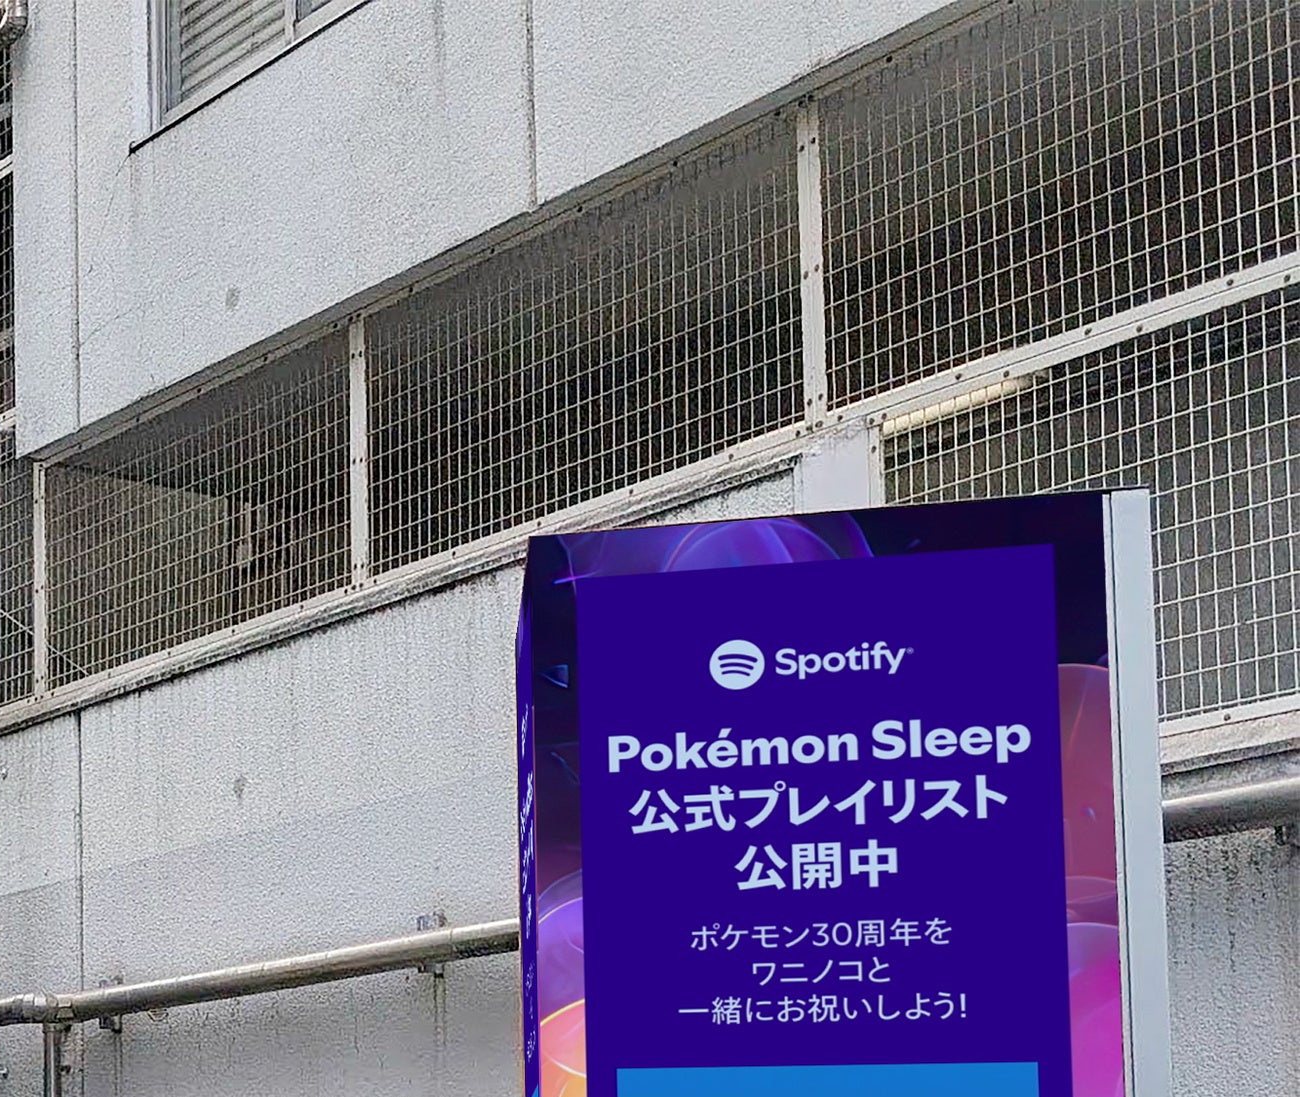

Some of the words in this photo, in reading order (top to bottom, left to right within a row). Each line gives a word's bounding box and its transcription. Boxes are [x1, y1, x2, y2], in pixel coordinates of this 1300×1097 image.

[775, 641, 906, 679] Spotify
[608, 728, 858, 772] Pokémon
[872, 719, 1031, 763] Sleep
[629, 774, 1007, 834] 公式プレイリスト
[735, 839, 897, 890] 公開中
[691, 918, 952, 950] ポケモン30周年を
[753, 957, 890, 985] ワニノコと
